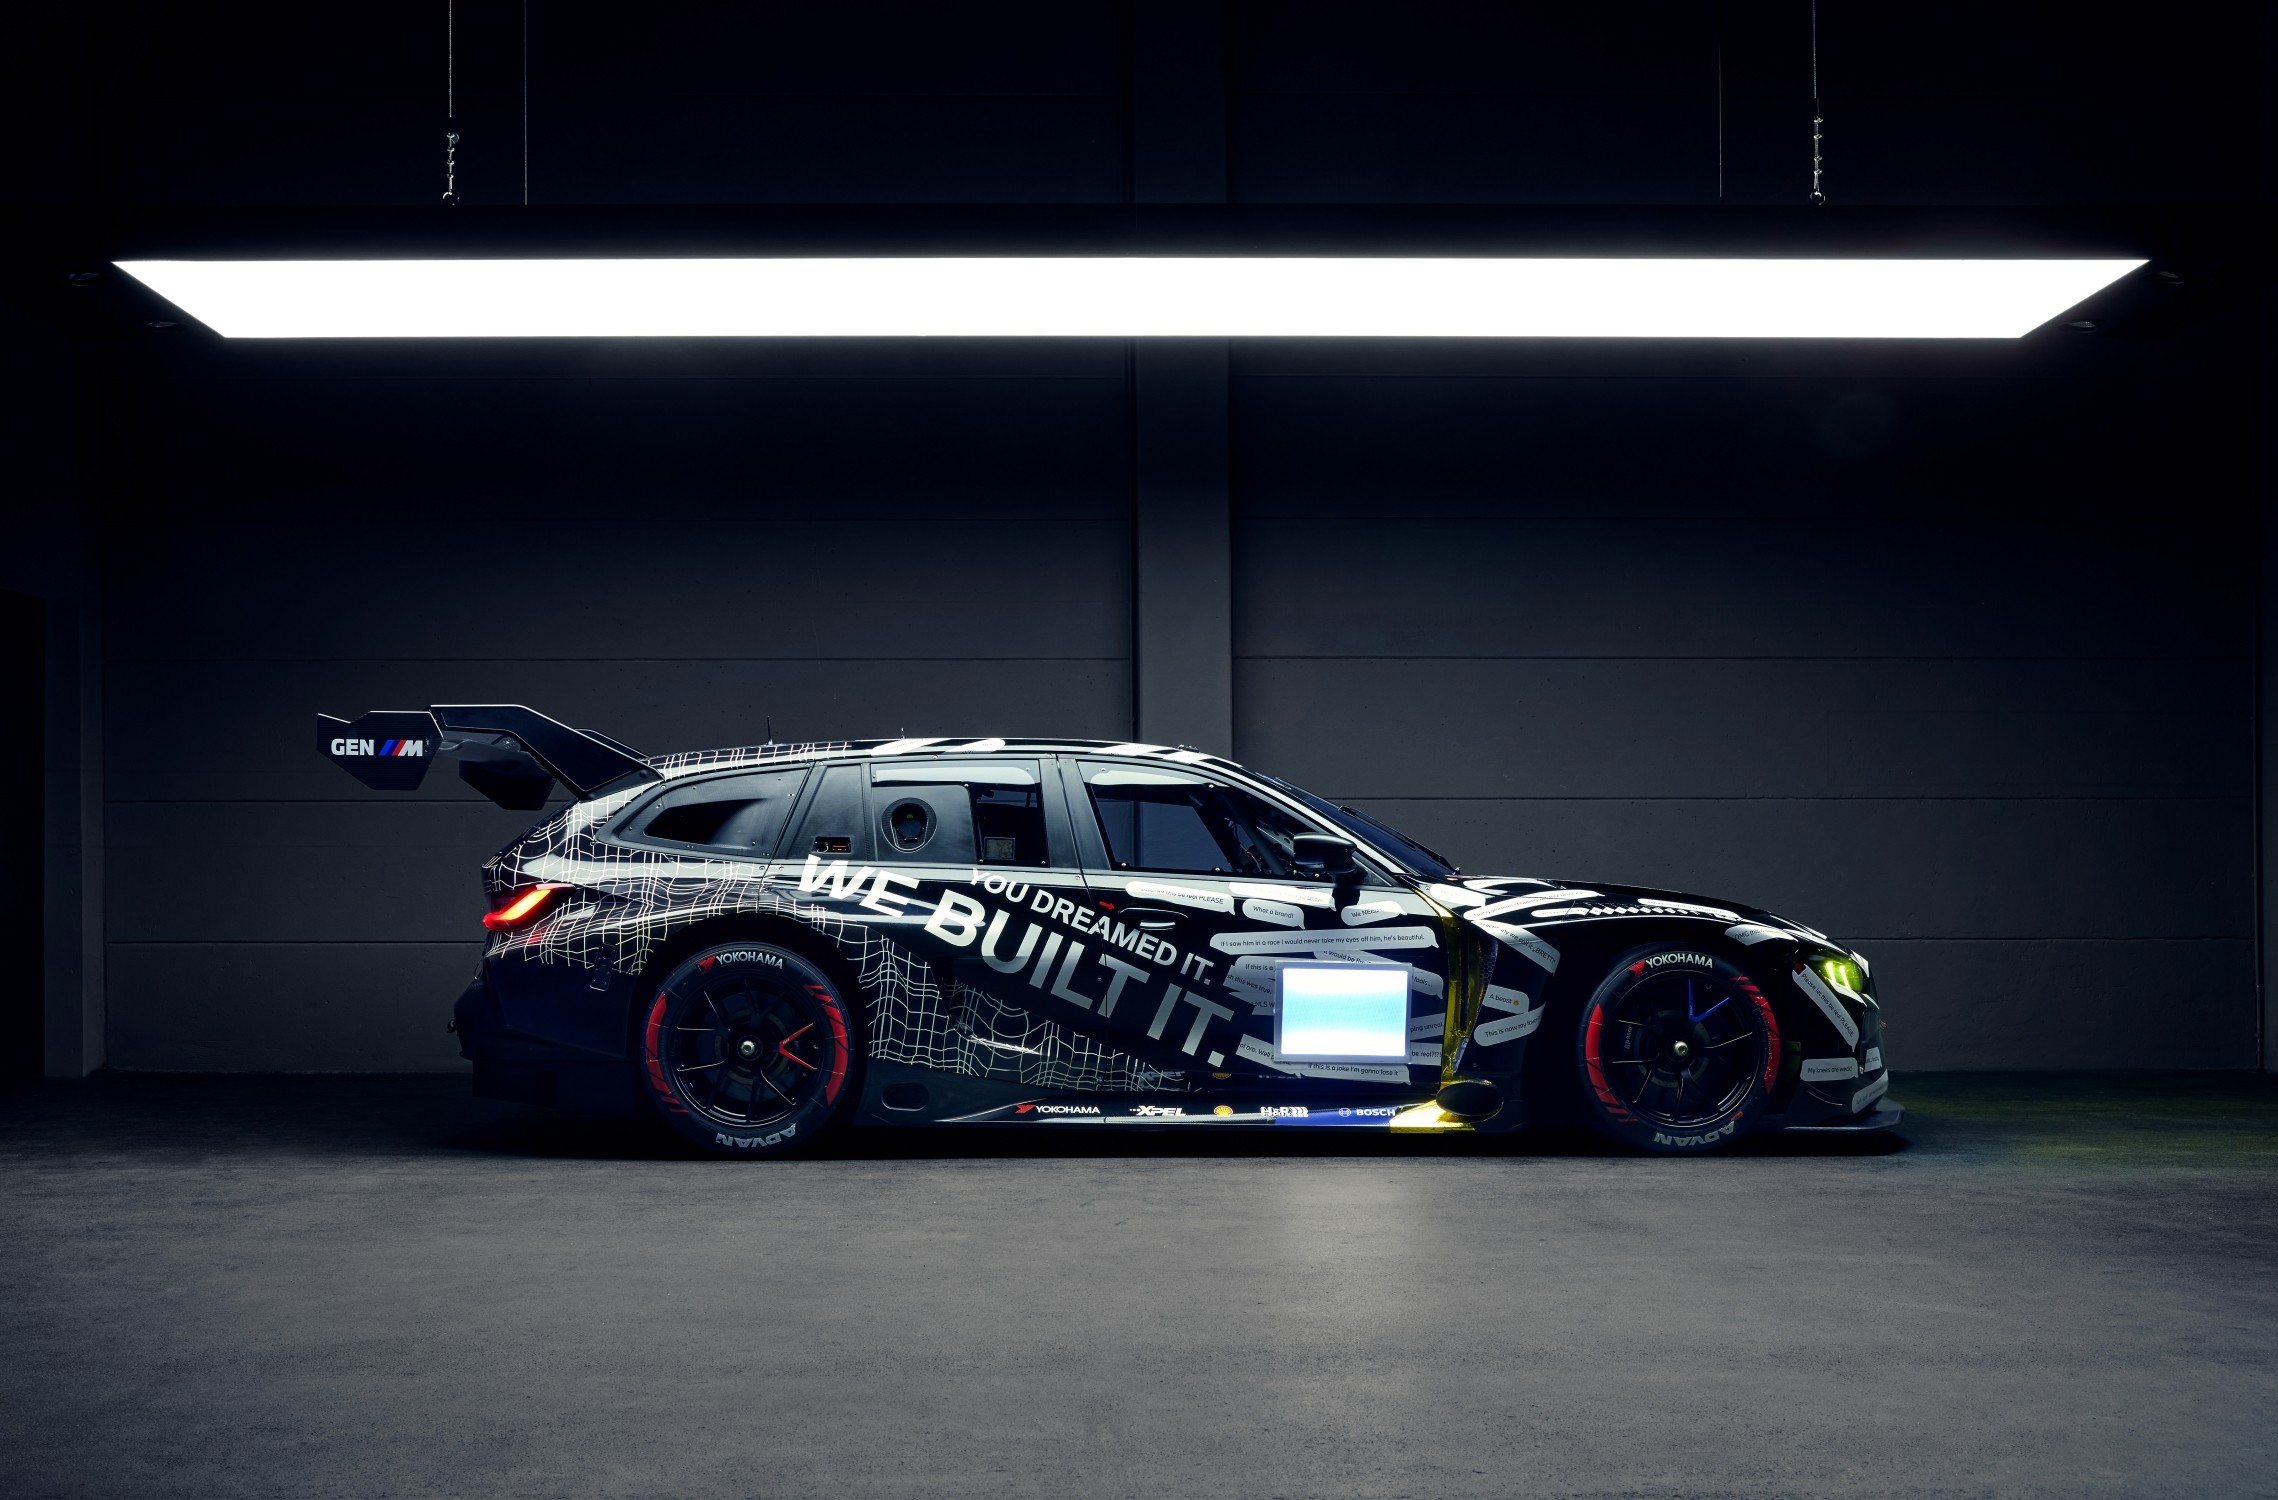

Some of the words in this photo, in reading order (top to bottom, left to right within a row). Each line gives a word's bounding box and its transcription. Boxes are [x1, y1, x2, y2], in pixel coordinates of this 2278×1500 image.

[330, 738, 375, 756] GEN
[1198, 894, 1225, 905] PLEASE
[1253, 905, 1269, 914] What
[968, 866, 1032, 904] YOU
[1030, 888, 1179, 968] DREAMED
[1179, 954, 1216, 986] IT.
[1369, 935, 1383, 943] him,
[715, 950, 784, 970] YOKOHAMA
[797, 853, 921, 919] WE
[922, 889, 1152, 1019] BUILT
[1146, 983, 1235, 1068] IT.
[1328, 950, 1347, 960] would
[1347, 955, 1355, 963] be
[1645, 952, 1714, 969] YOKOHAMA
[1250, 963, 1262, 971] this
[1234, 975, 1246, 985] this
[1246, 981, 1259, 990] was
[1495, 994, 1513, 1004] beast
[1484, 1030, 1498, 1038] This
[1504, 1025, 1518, 1033] now
[1517, 1022, 1528, 1030] my
[1335, 1065, 1350, 1073] joke
[1380, 1068, 1394, 1076] lose
[1035, 1105, 1101, 1114] YOKOHAMA
[1356, 1108, 1397, 1117] BOSCH
[714, 1122, 798, 1150] ADVAN
[1652, 1119, 1737, 1148] ADVAN
